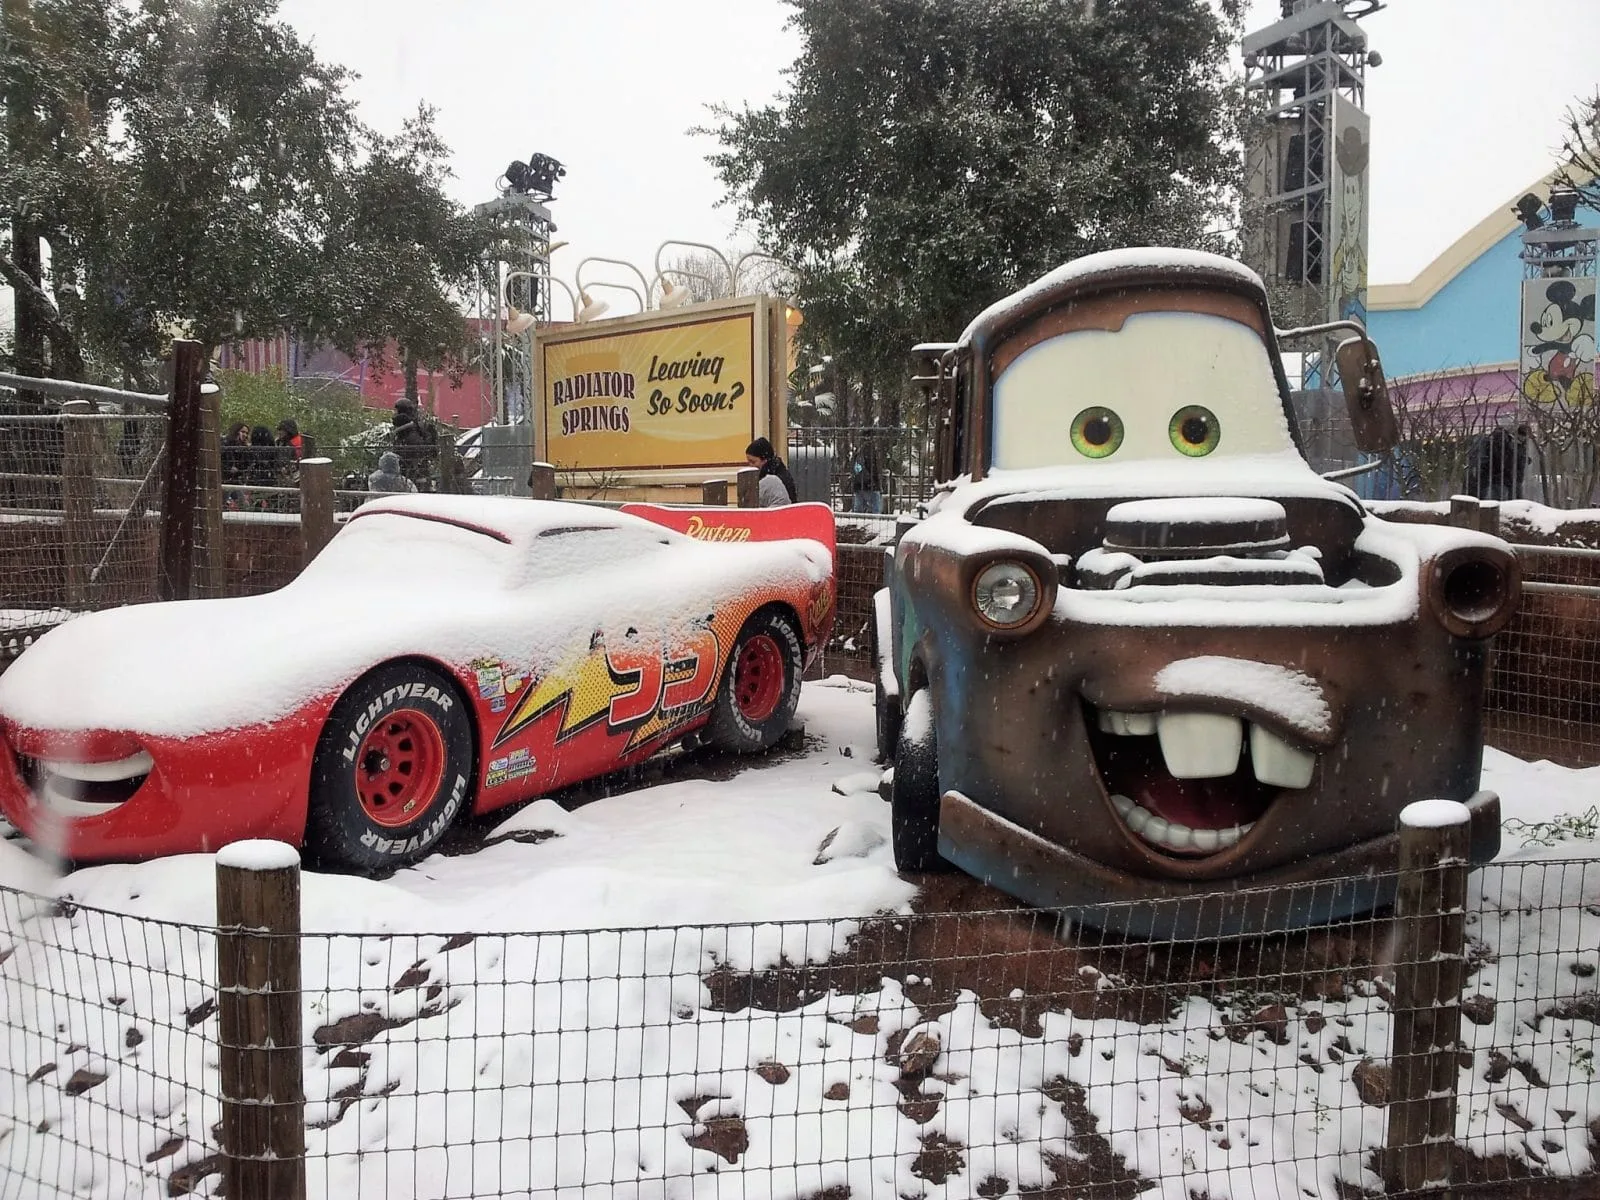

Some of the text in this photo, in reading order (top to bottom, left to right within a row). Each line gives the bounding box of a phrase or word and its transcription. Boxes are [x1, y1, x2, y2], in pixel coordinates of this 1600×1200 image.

[647, 351, 725, 384] Leaving
[553, 371, 635, 407] RADIATOR
[647, 381, 745, 416] So Soon?
[562, 405, 630, 436] SPRINGS
[343, 682, 453, 762] LIGHTYEAR
[360, 773, 466, 855] LIGHTYEAR
